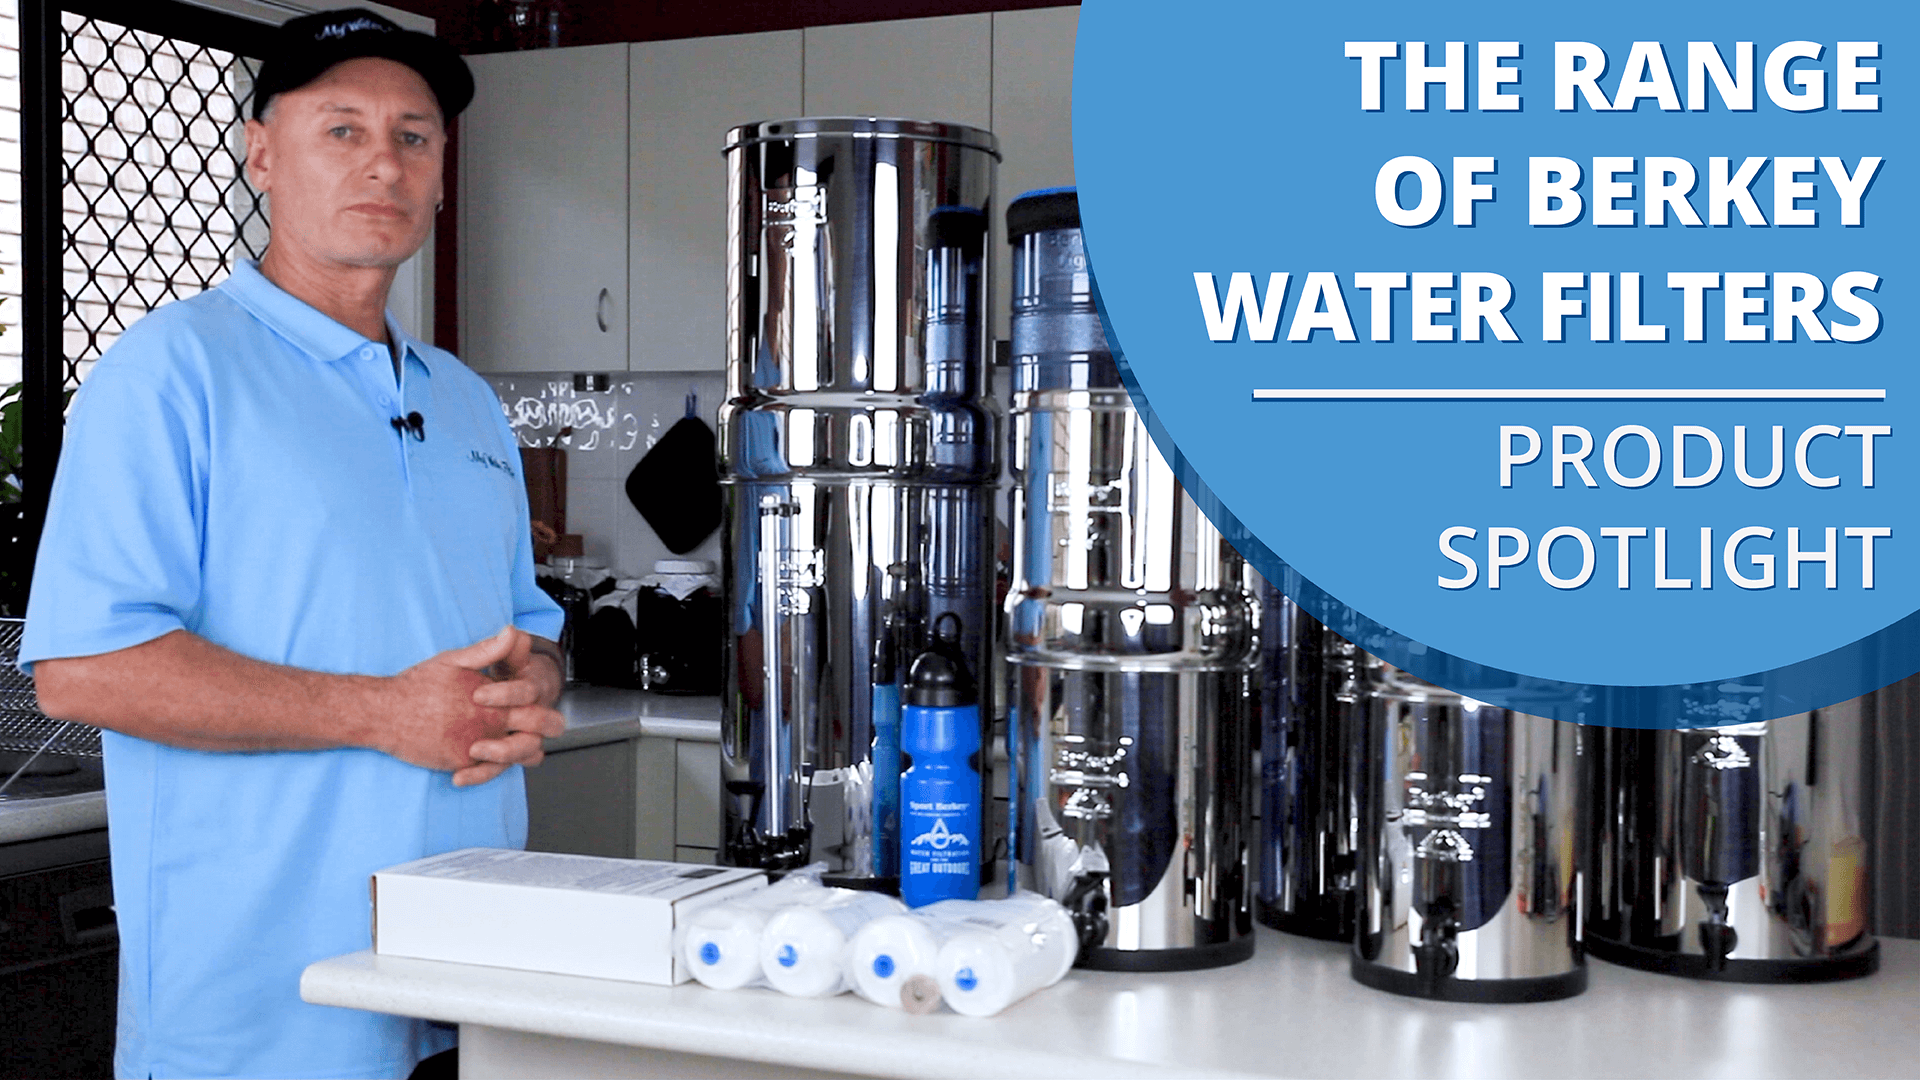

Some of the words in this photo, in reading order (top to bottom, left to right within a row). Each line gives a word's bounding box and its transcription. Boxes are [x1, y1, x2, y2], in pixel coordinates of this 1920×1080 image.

[909, 801, 933, 811] Sport
[935, 802, 969, 811] Berkey
[909, 861, 930, 875] GREAT
